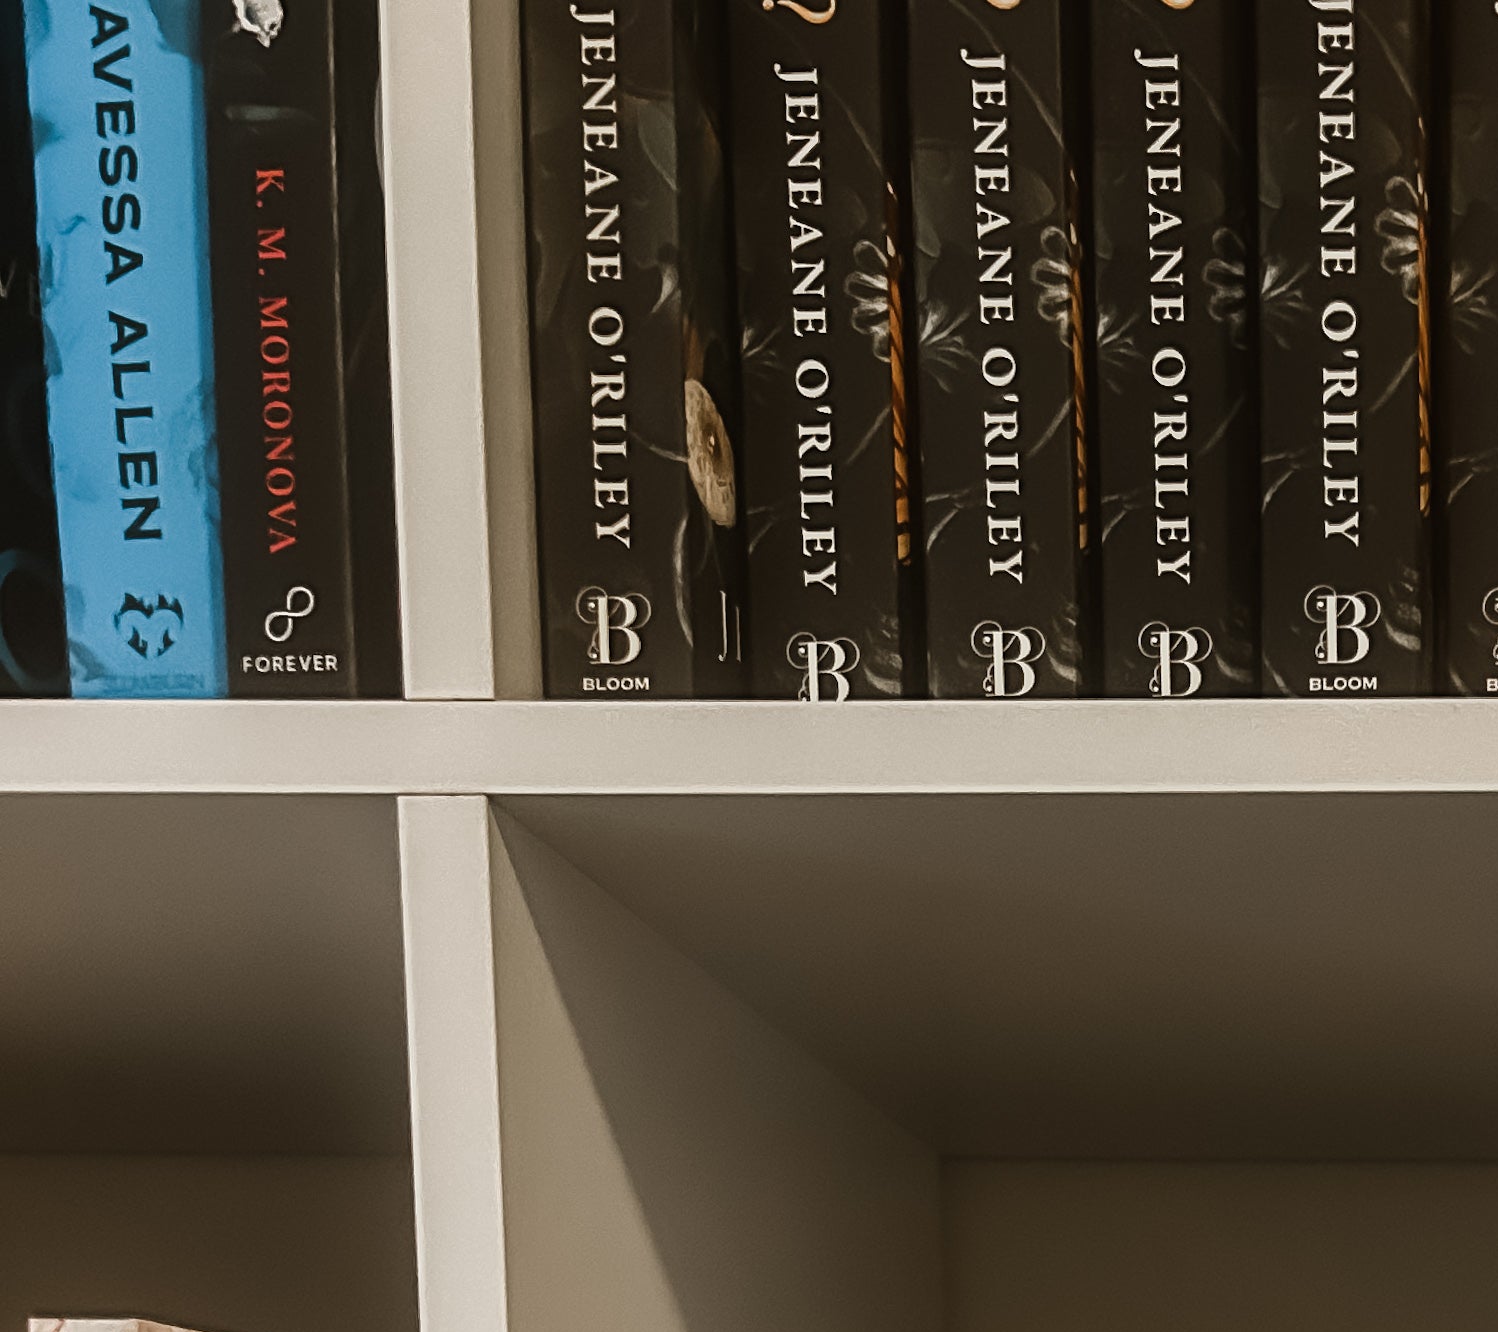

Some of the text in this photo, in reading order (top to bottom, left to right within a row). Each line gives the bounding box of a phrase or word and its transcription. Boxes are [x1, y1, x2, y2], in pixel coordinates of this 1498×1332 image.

[108, 312, 163, 541] ALLEN
[255, 168, 297, 555] K. M. MORONOVA
[570, 4, 632, 550] JENEANE O'RILEY
[774, 63, 838, 596] JENEANE O'RILEY
[961, 48, 1025, 585] JENEANE O'RILEY
[1134, 48, 1191, 585] JENEANE O'RILEY
[1309, 0, 1361, 548] JENEANE O'RILEY
[242, 655, 339, 673] FOREVER
[583, 677, 650, 692] BLOOM
[1308, 677, 1378, 692] BLOOM
